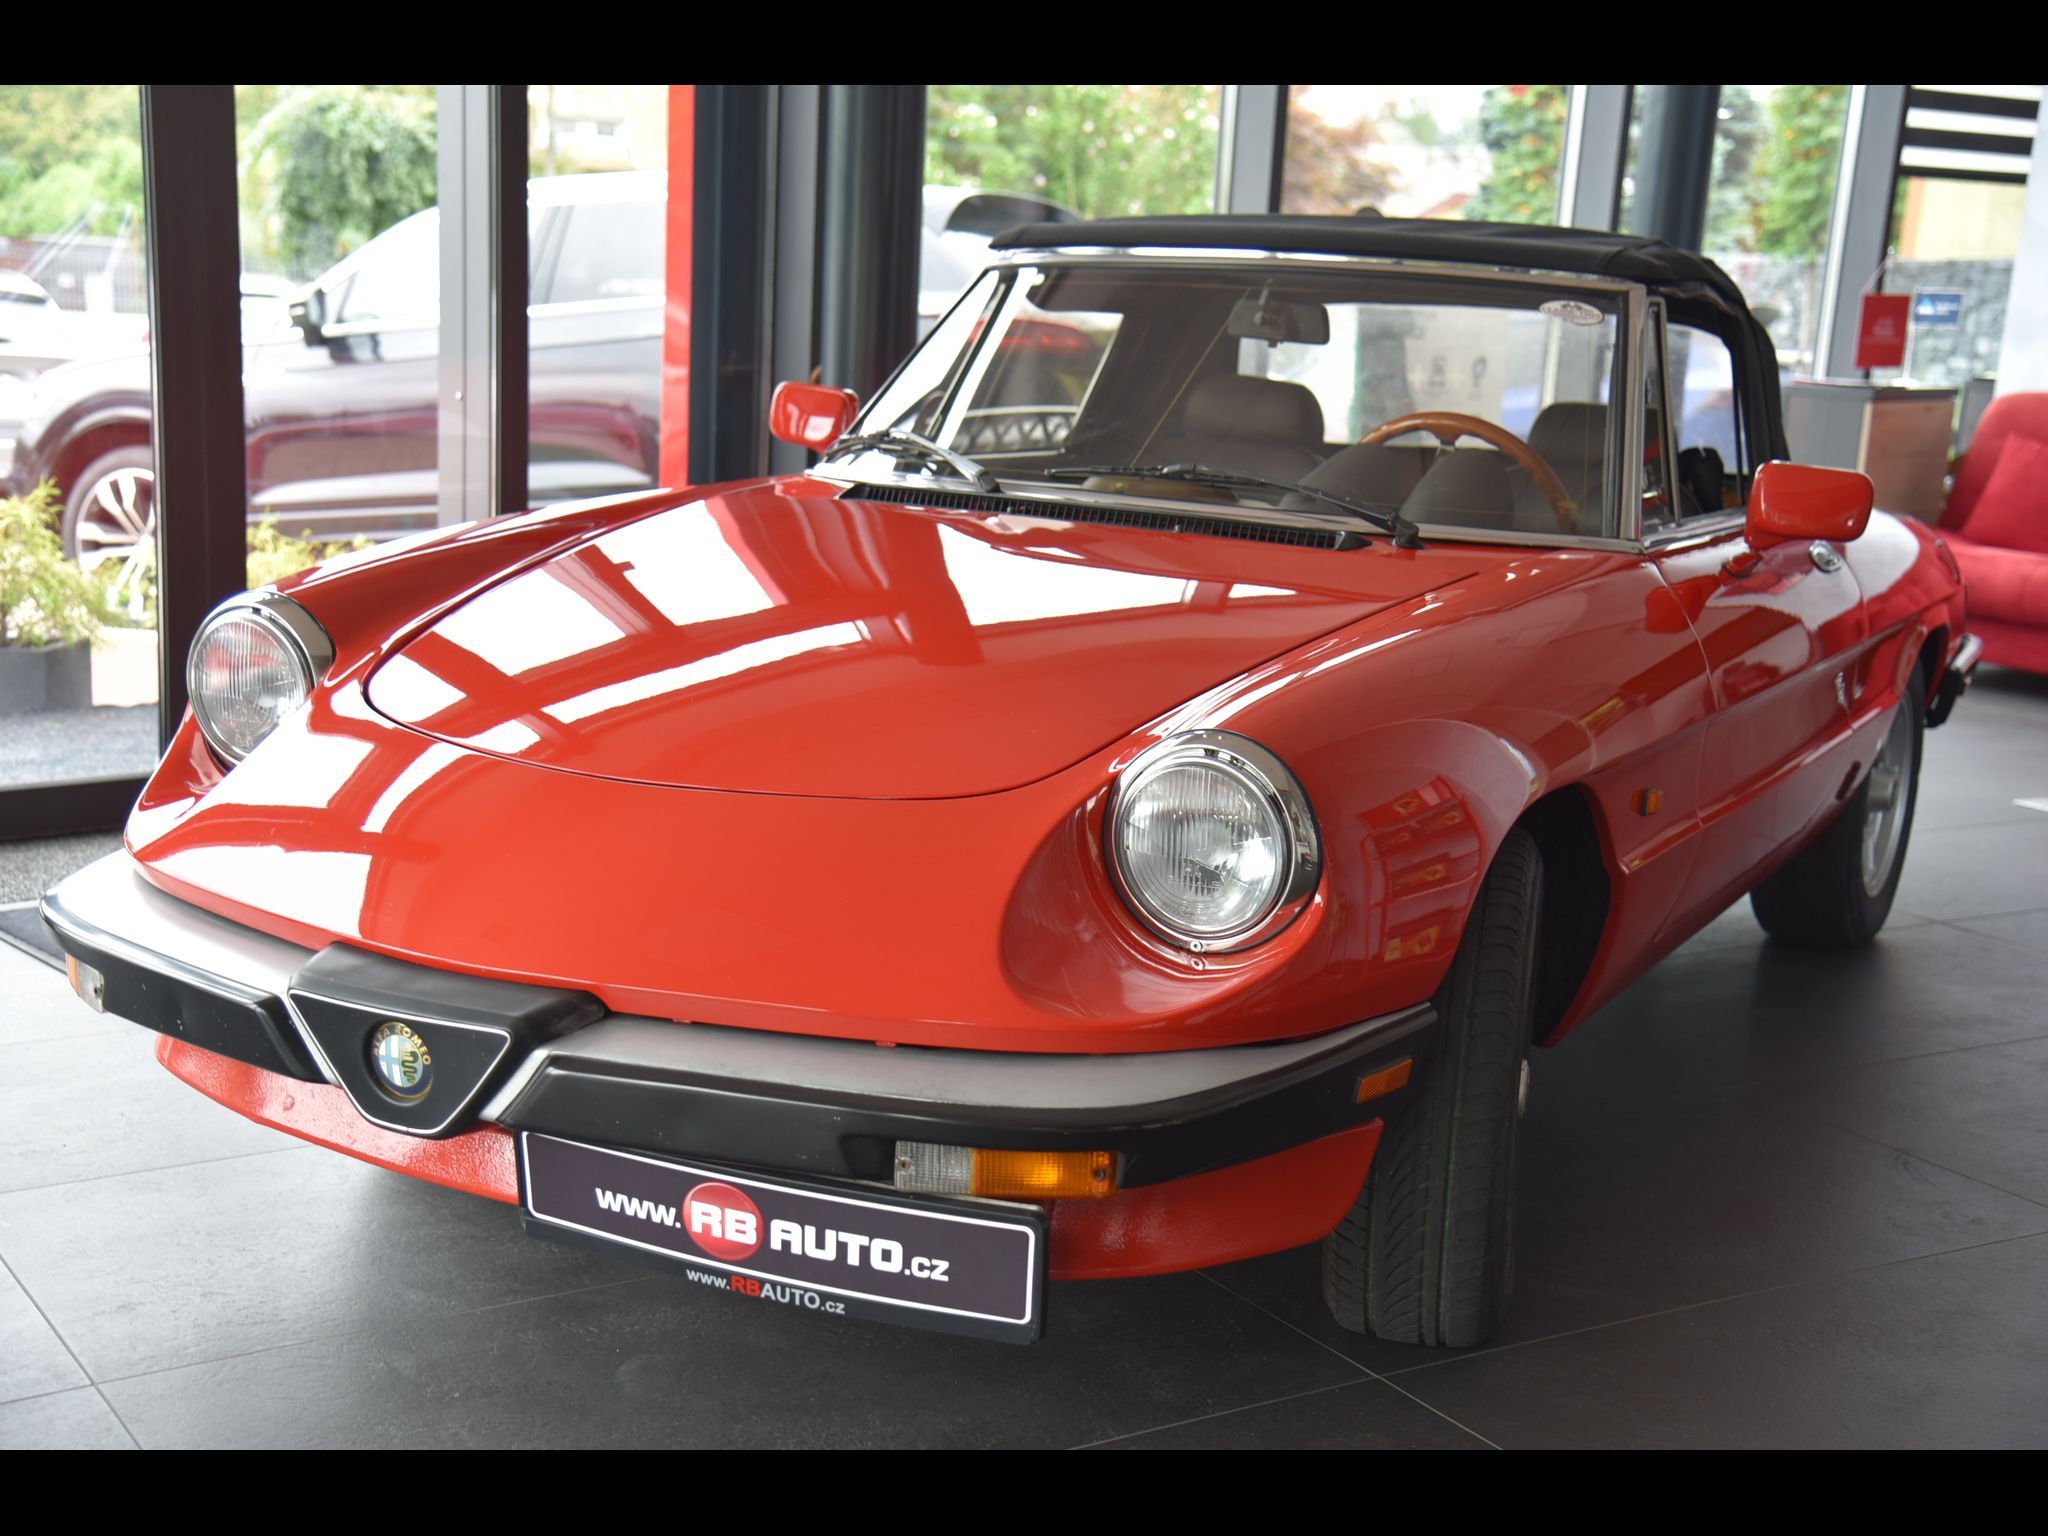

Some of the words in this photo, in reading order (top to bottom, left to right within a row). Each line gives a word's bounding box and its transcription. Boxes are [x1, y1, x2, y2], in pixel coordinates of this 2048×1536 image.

[373, 1028, 391, 1056] ALFA
[395, 1025, 431, 1065] ROMEO
[686, 1269, 845, 1314] www.RBAUTO.cz
